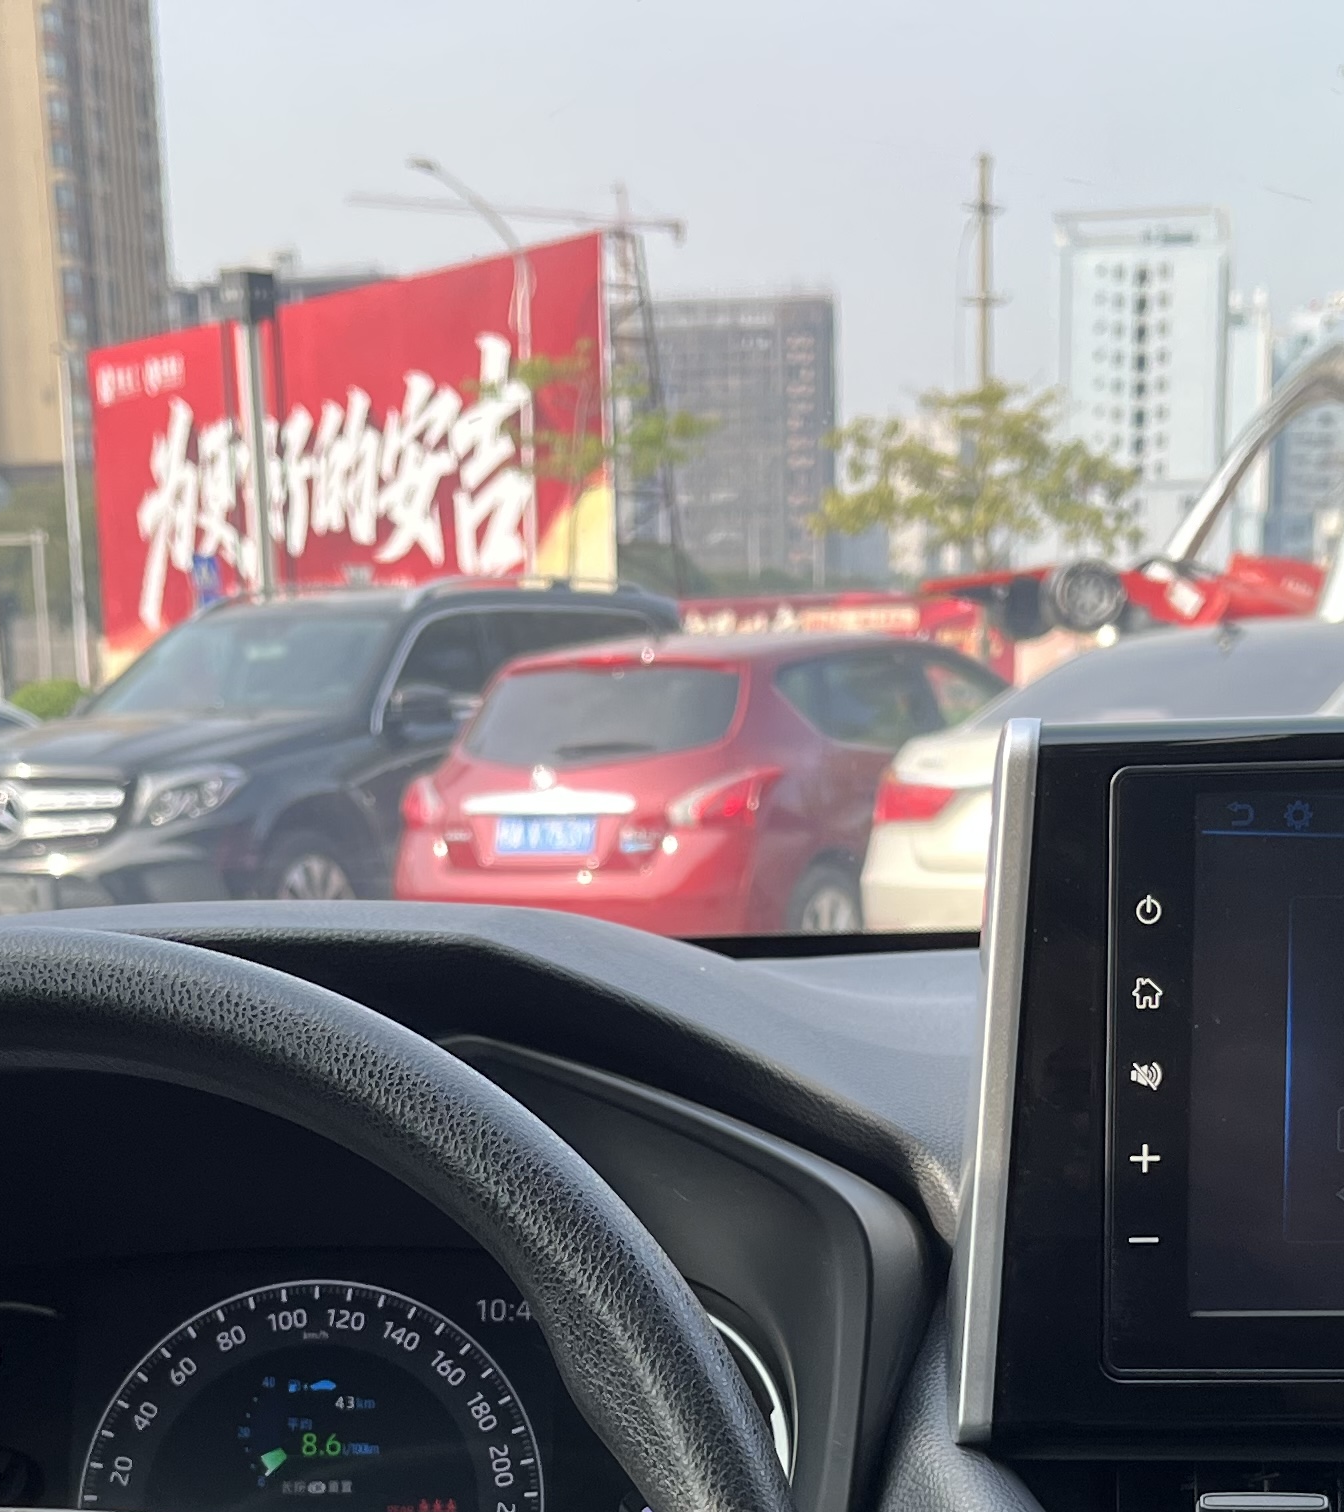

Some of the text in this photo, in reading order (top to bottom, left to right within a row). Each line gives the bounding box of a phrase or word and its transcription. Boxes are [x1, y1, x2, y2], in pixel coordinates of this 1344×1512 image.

[266, 1308, 308, 1331] 100
[327, 1308, 365, 1331] 120
[476, 1298, 532, 1321] 10:4
[216, 1325, 246, 1351] 80
[383, 1321, 420, 1351] 140
[170, 1357, 197, 1386] 60
[431, 1350, 466, 1387] 160
[133, 1401, 158, 1431] 40
[335, 1395, 355, 1410] 43
[467, 1391, 498, 1432] 180
[302, 1432, 342, 1456] 8.6
[109, 1456, 133, 1486] 20
[488, 1444, 514, 1488] 200
